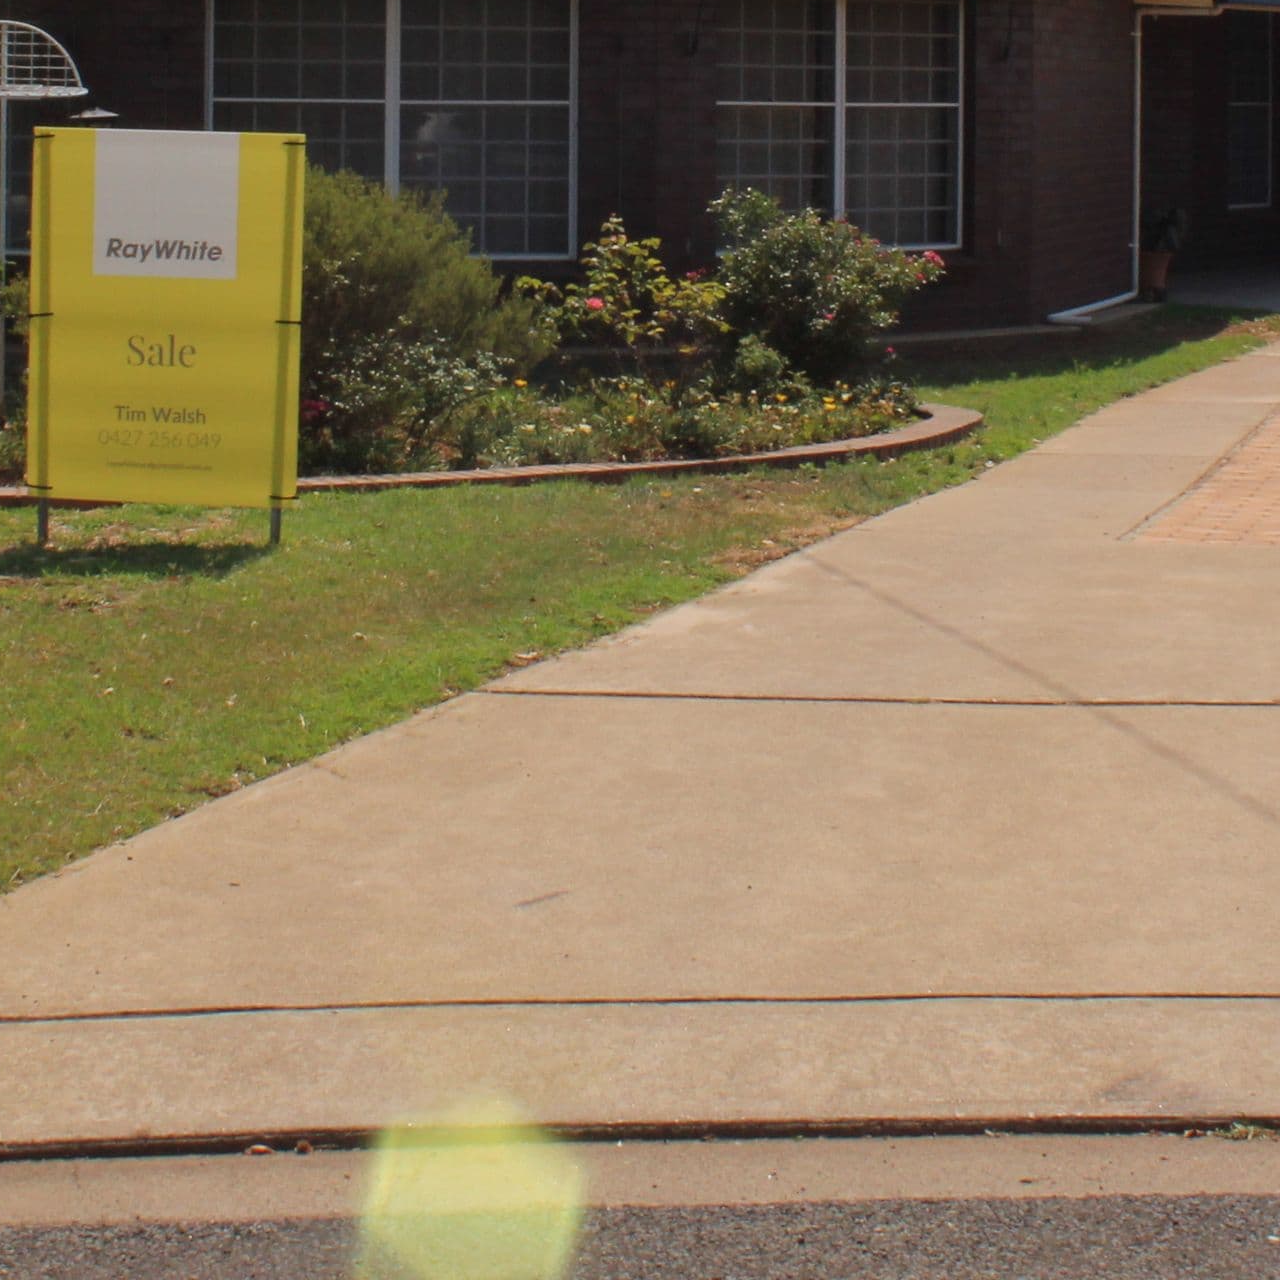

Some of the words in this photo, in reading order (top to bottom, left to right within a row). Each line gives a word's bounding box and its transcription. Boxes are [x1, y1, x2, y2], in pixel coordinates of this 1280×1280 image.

[127, 334, 197, 368] Sale
[114, 405, 147, 422] Tim
[152, 406, 207, 424] Walsh
[97, 429, 144, 446] 0427
